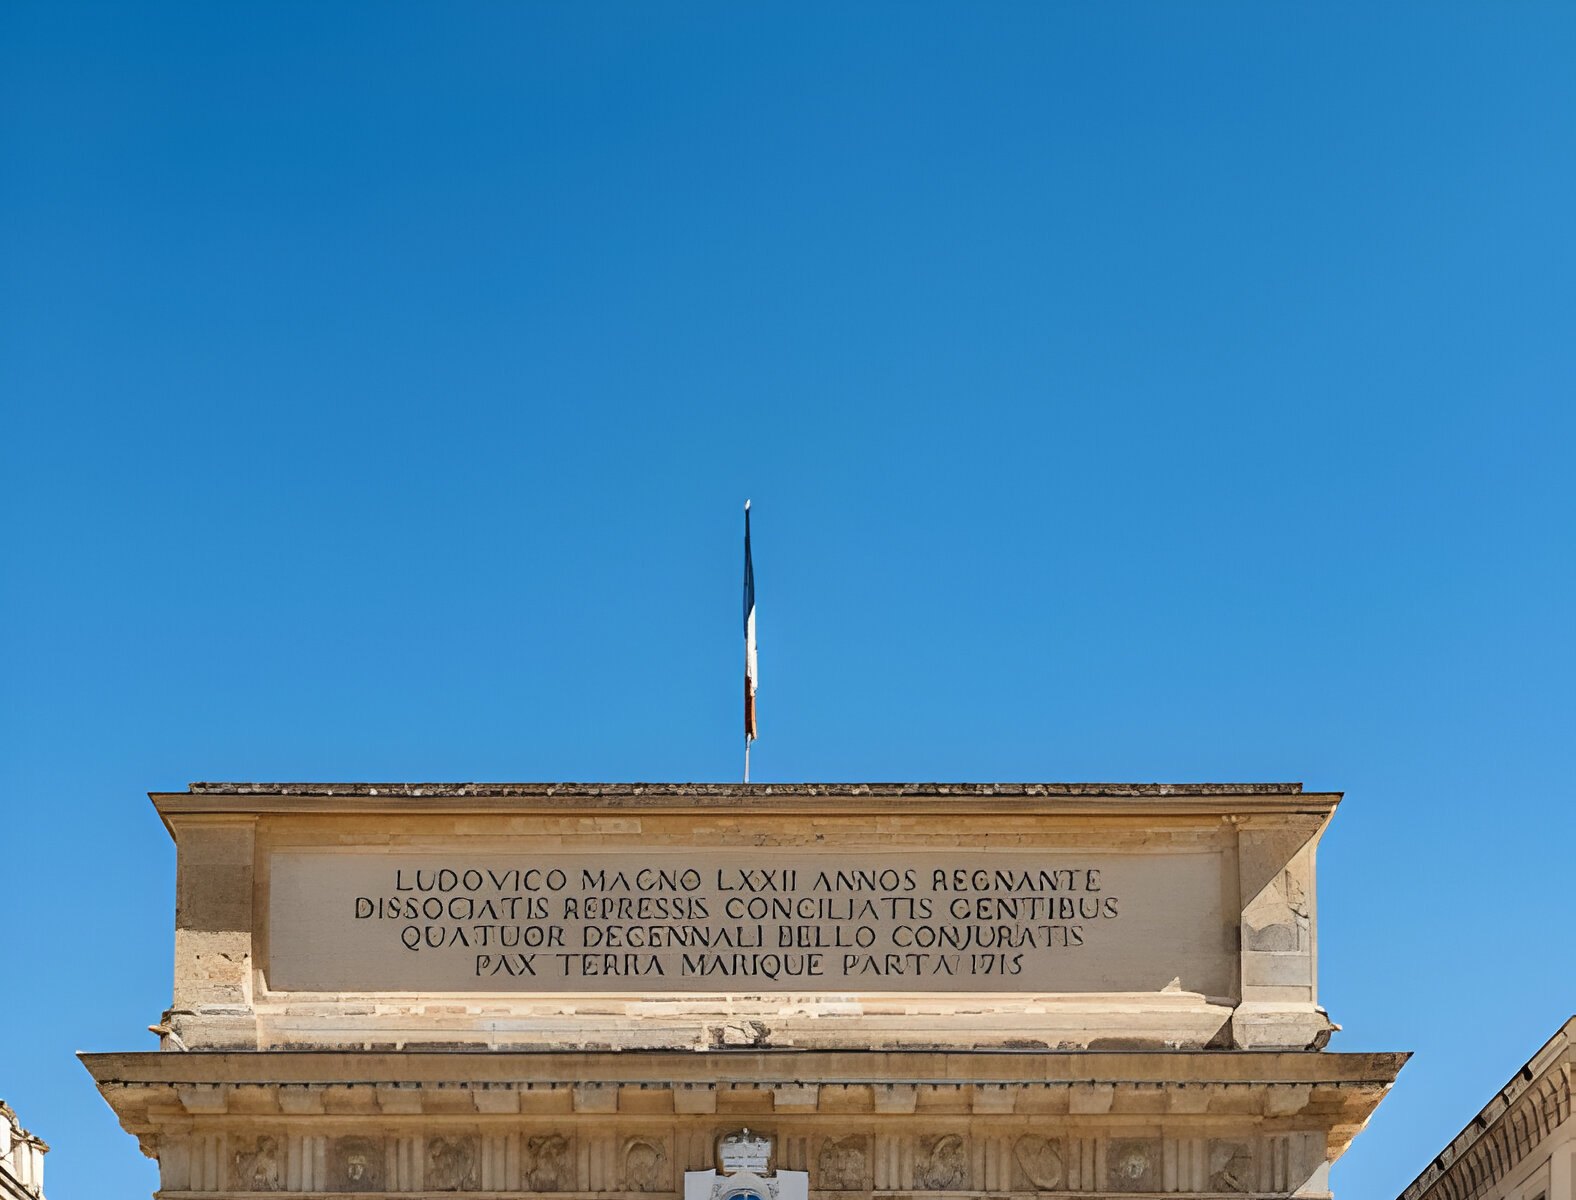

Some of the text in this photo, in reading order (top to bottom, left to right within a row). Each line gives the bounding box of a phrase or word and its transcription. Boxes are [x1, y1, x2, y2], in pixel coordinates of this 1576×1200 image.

[396, 869, 1101, 892] LUDOVICO MAGNO LXXII ANNOS REGNANTE
[564, 897, 710, 920] REPRESSIS
[725, 897, 933, 920] CONCILIATIS
[401, 925, 566, 951] QUATUOR
[475, 953, 538, 976] PAX
[681, 953, 824, 980] MARIQUE
[971, 953, 1024, 975] 1715
